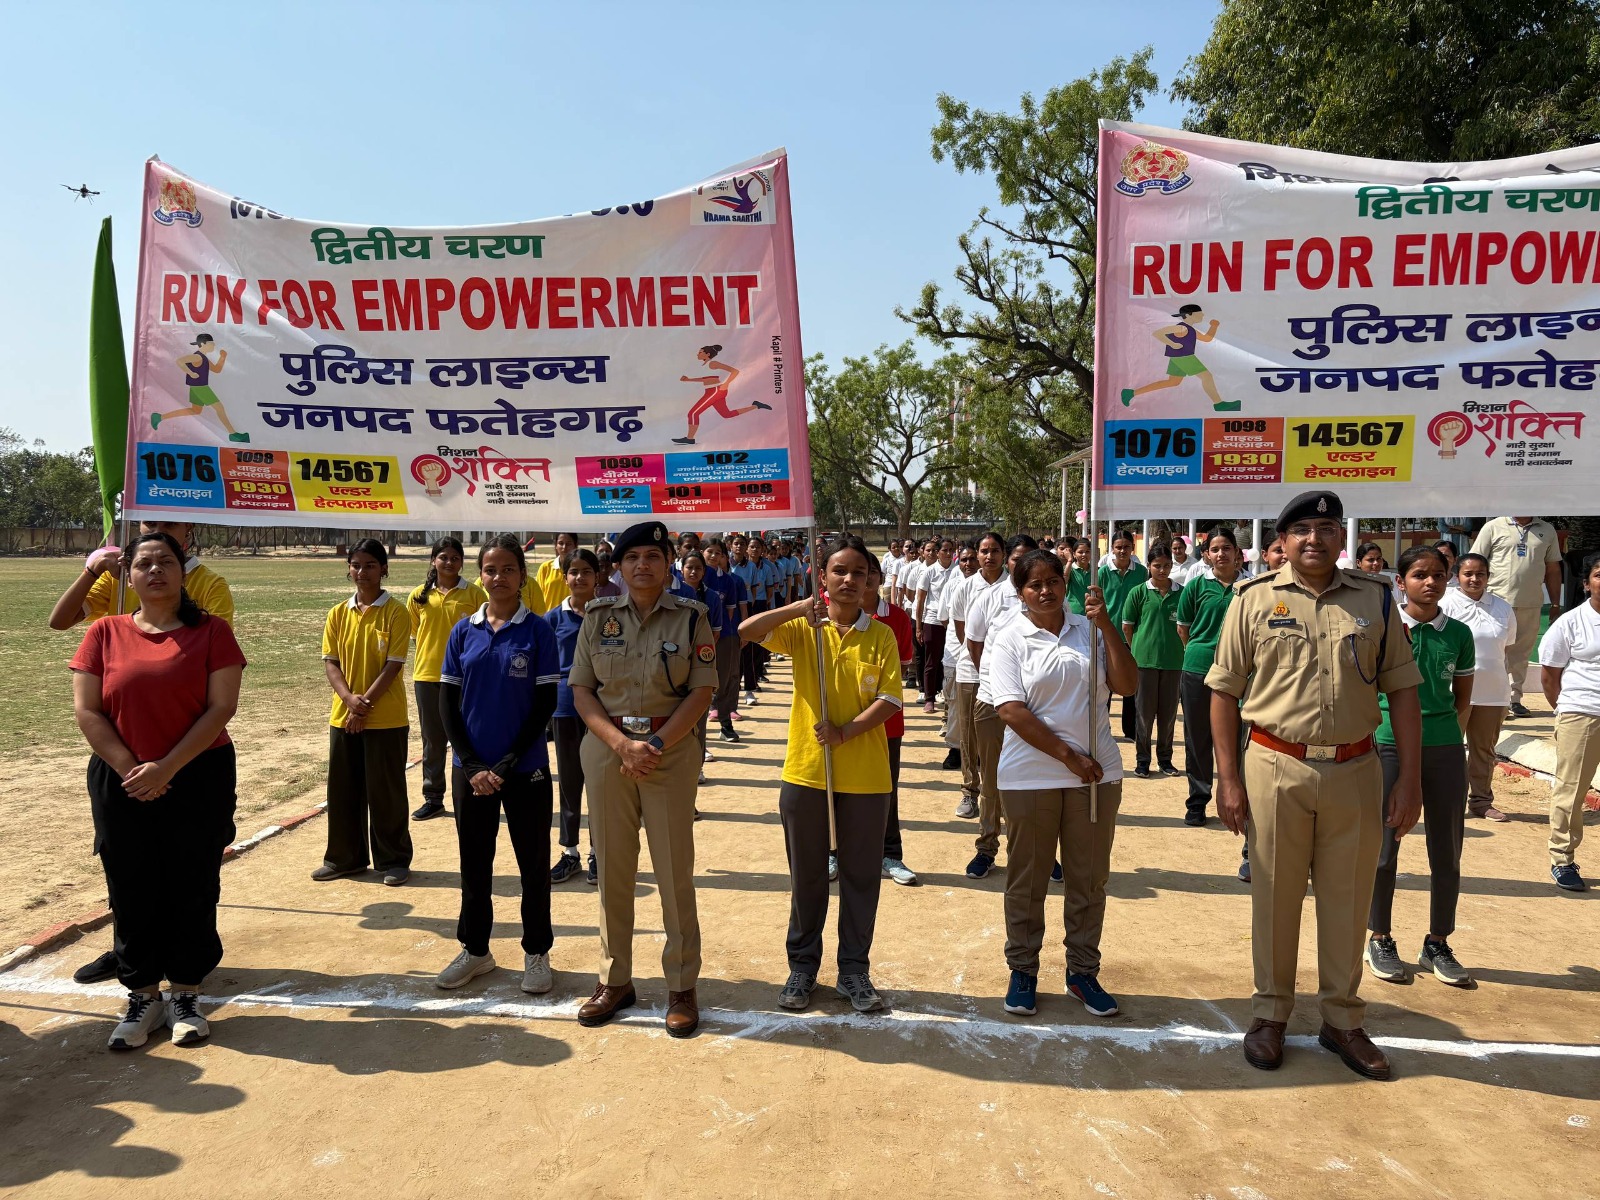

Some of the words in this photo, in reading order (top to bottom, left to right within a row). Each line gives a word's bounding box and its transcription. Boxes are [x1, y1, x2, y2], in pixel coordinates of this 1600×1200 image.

[1355, 185, 1493, 219] द्वितीय
[1504, 189, 1600, 212] चरण
[703, 210, 731, 222] VAAMA
[731, 210, 762, 222] SAARTHI
[310, 226, 433, 265] द्वितीय
[443, 235, 545, 260] चरण
[1132, 241, 1244, 296] RUN
[1263, 236, 1373, 291] FOR
[1393, 230, 1600, 287] EMPOW
[161, 273, 247, 325] RUN
[258, 279, 346, 331] FOR
[351, 274, 758, 332] EMPOWERMENT
[1288, 303, 1453, 360] पुलिस
[770, 335, 783, 356] Kapil
[280, 344, 414, 397] पुलिस
[426, 355, 611, 390] लाइन्स
[1255, 363, 1445, 394] जनपद
[1460, 348, 1600, 390] फतेह
[773, 364, 784, 394] Printers
[1462, 400, 1509, 413] मिशन
[257, 402, 415, 434] जनपद
[425, 398, 646, 443] फतेहगढ़
[1221, 420, 1267, 433] 1098
[1292, 421, 1405, 448] 14567
[1474, 399, 1587, 459] शक्ति
[1108, 427, 1197, 459] 1076
[1212, 440, 1275, 449] हेल्पलाइन
[1506, 441, 1526, 449] नारी
[1529, 441, 1555, 451] सुरक्षा
[234, 450, 275, 464] 1098
[436, 445, 478, 457] मिशन
[701, 451, 750, 465] 102
[1326, 450, 1378, 463] एल्डर
[1505, 450, 1525, 458] नारी
[1528, 450, 1561, 458] सम्मान
[139, 450, 217, 483] 1076
[596, 457, 644, 470] 1090
[1208, 453, 1277, 466] 1930
[1504, 458, 1525, 467] नारी
[227, 470, 282, 479] हेल्पलाइन
[296, 458, 390, 484] 14567
[451, 445, 553, 498] शक्ति
[1116, 462, 1189, 477] हेल्पलाइन
[1304, 463, 1397, 479] हेल्पलाइन
[619, 476, 658, 484] लाइन
[1208, 473, 1275, 481] हेल्पलाइन
[148, 483, 213, 499] हेल्पलाइन
[229, 480, 288, 495] 1930
[327, 486, 372, 497] एल्डर
[484, 482, 503, 490] नारी
[504, 483, 529, 492] सुरक्षा
[485, 490, 504, 498] नारी
[593, 487, 636, 500] 112
[664, 485, 702, 498] 101
[735, 483, 773, 494] 108
[231, 499, 290, 508] हेल्पलाइन
[312, 495, 394, 511] हेल्पलाइन
